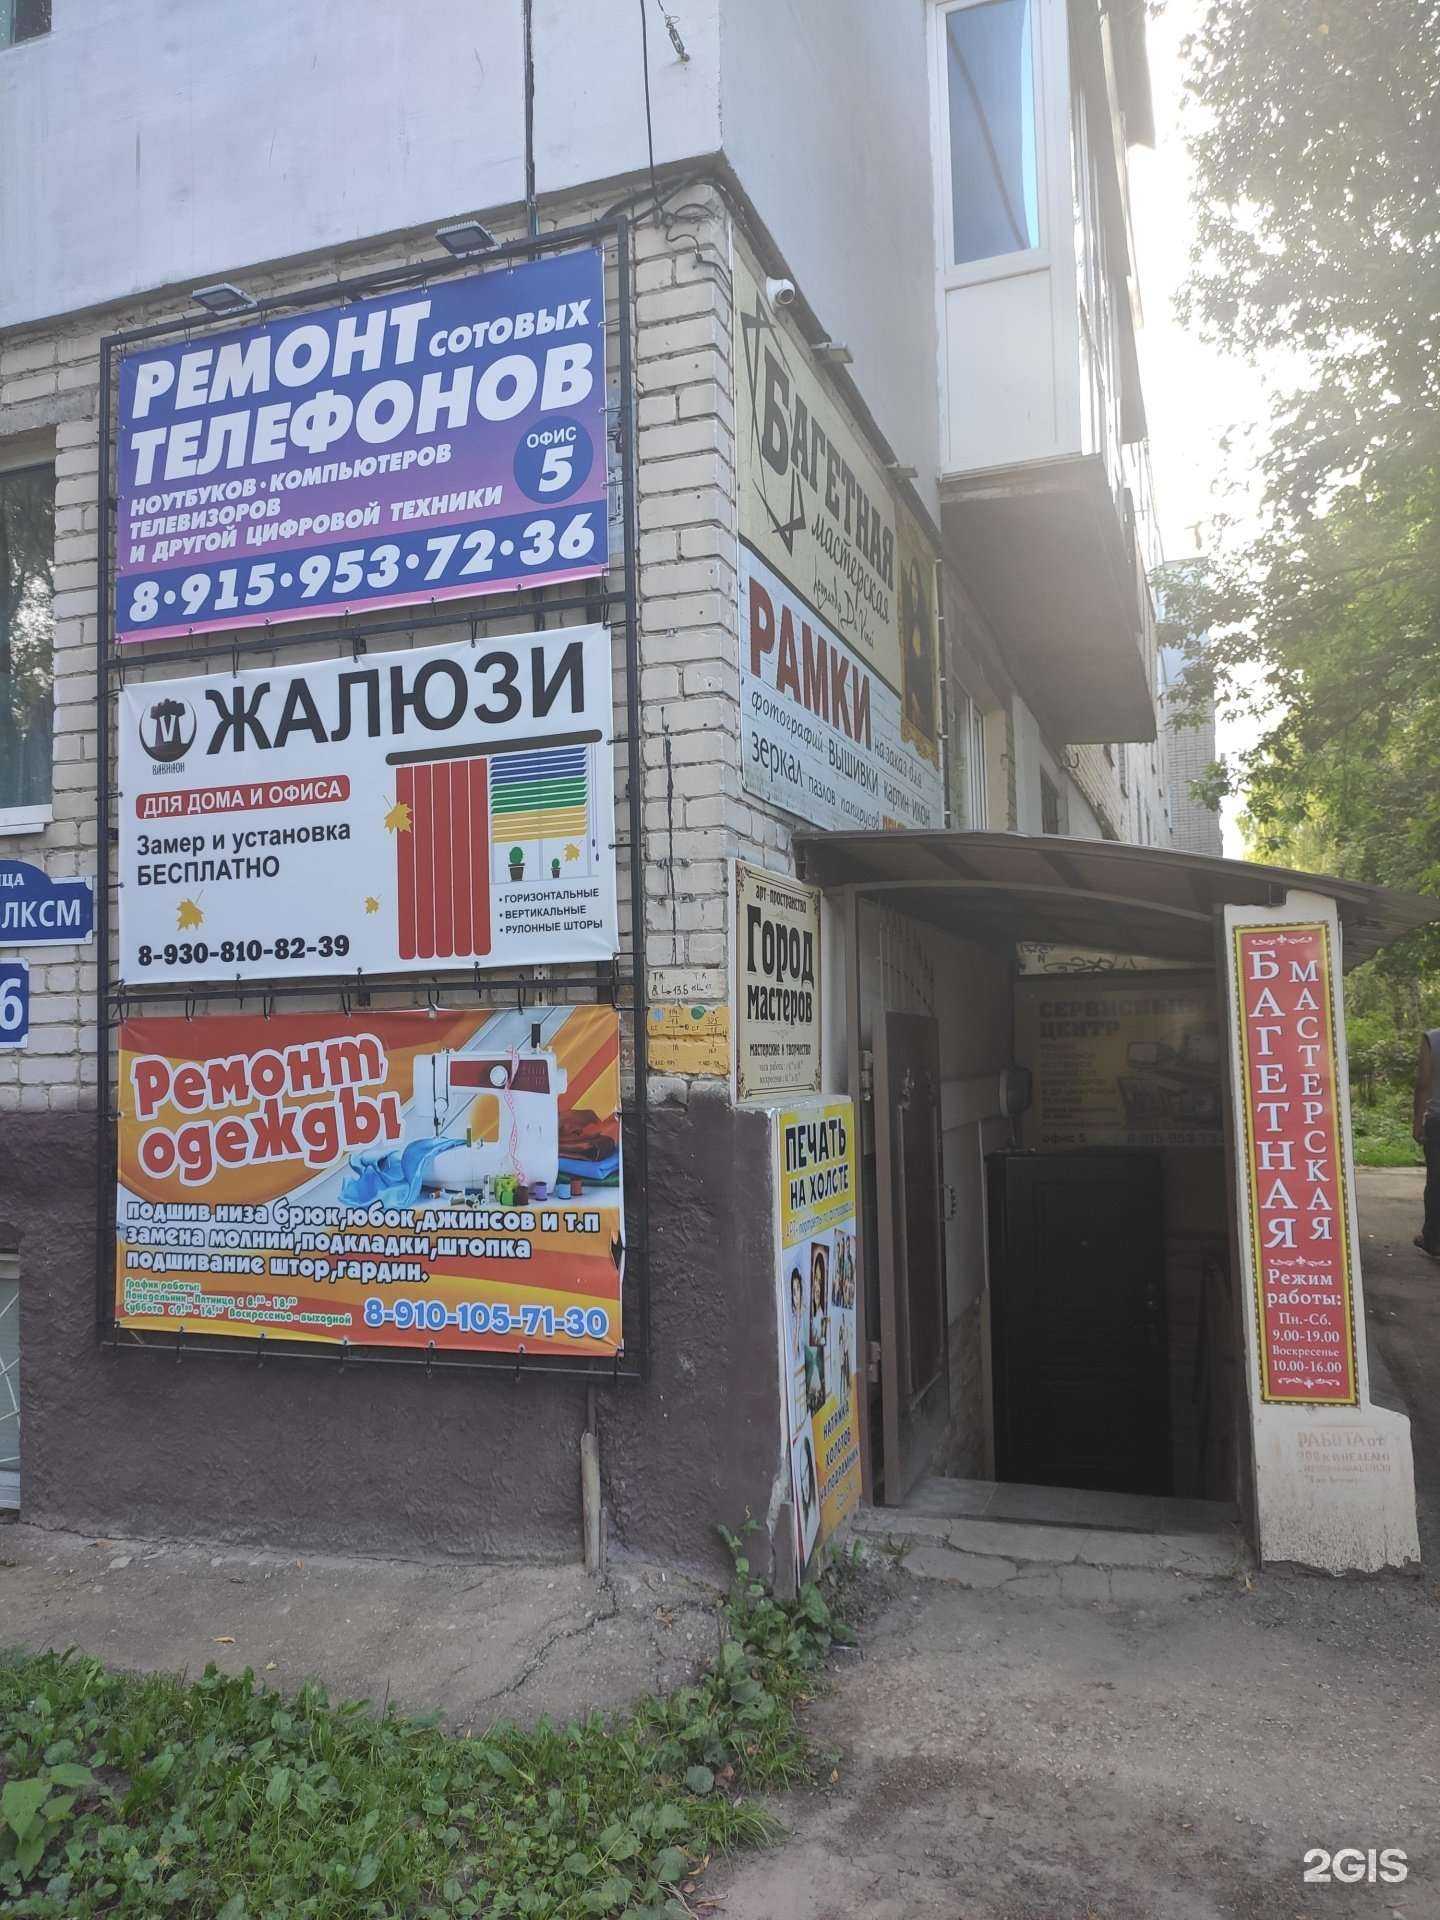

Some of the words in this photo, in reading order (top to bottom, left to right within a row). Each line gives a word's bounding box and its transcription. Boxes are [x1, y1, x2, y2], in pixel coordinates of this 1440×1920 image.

[131, 300, 431, 419] РЕМОНТ
[429, 299, 592, 358] СОТОВЫХ
[130, 343, 593, 486] ТЕЛЕФОНОВ
[526, 426, 577, 450] ОФИС
[131, 478, 257, 517] НОУТБУКОВ
[269, 443, 452, 491] КОМПЬЮТЕРОВ
[538, 446, 573, 492] 5
[761, 345, 894, 591] БАГЕТНАЯ
[130, 542, 145, 563] И
[152, 526, 237, 562] ДРУГОЙ
[246, 502, 380, 547] ЦИФРОВОЙ
[390, 486, 502, 522] ТЕХНИКИ
[131, 498, 280, 539] ТЕЛЕВИЗОРОВ
[749, 576, 873, 752] РАМКИ
[205, 641, 585, 755] ЖАЛЮЗИ
[751, 692, 824, 752] фотографий
[828, 738, 880, 797] ВЫШИВКИ
[751, 731, 804, 788] зеркал
[143, 795, 182, 818] ДЛЯ
[187, 790, 245, 815] ДОМА
[250, 787, 264, 806] И
[269, 779, 342, 803] ОФИСА
[137, 832, 206, 861] Замер
[212, 835, 226, 850] и
[232, 823, 351, 854] установка
[137, 855, 280, 887] БЕСПЛАТНО
[504, 887, 600, 905] ГОРИЗОНТАЛЬНЫЕ
[505, 904, 587, 920] ВЕРТИКАЛЬНЫЕ
[505, 921, 560, 935] РУЛОННЫЕ
[564, 919, 604, 933] ШТОРЫ
[747, 904, 815, 990] Город
[138, 935, 350, 967] 8-930-810-82-39
[747, 985, 813, 1025] мастеров
[130, 1034, 388, 1120] Ремонт
[1248, 950, 1298, 1249] БАГЕТНАЯ
[1289, 960, 1333, 1241] МАСТЕРСКАЯ
[141, 1086, 402, 1183] одежды
[785, 1118, 846, 1172] ПЕЧАТЬ
[790, 1180, 806, 1210] НА
[809, 1164, 849, 1203] ХОЛСТЕ
[126, 1201, 211, 1225] подшив
[214, 1205, 268, 1227] низа
[541, 1212, 558, 1231] и
[126, 1226, 204, 1249] замена
[126, 1251, 264, 1277] подшивание
[1268, 1268, 1333, 1286] Режим
[124, 1290, 187, 1304] Понедельник
[194, 1294, 235, 1307] Пятница
[125, 1278, 158, 1291] График
[1267, 1289, 1342, 1308] работы:
[124, 1302, 164, 1315] Суббота
[299, 1313, 353, 1327] выходной
[363, 1298, 609, 1338] 8-910-105-71-30
[1272, 1329, 1339, 1343] 9.00-19.00
[1272, 1345, 1340, 1359] Воскресенье
[1272, 1360, 1342, 1373] 10.00-16.00
